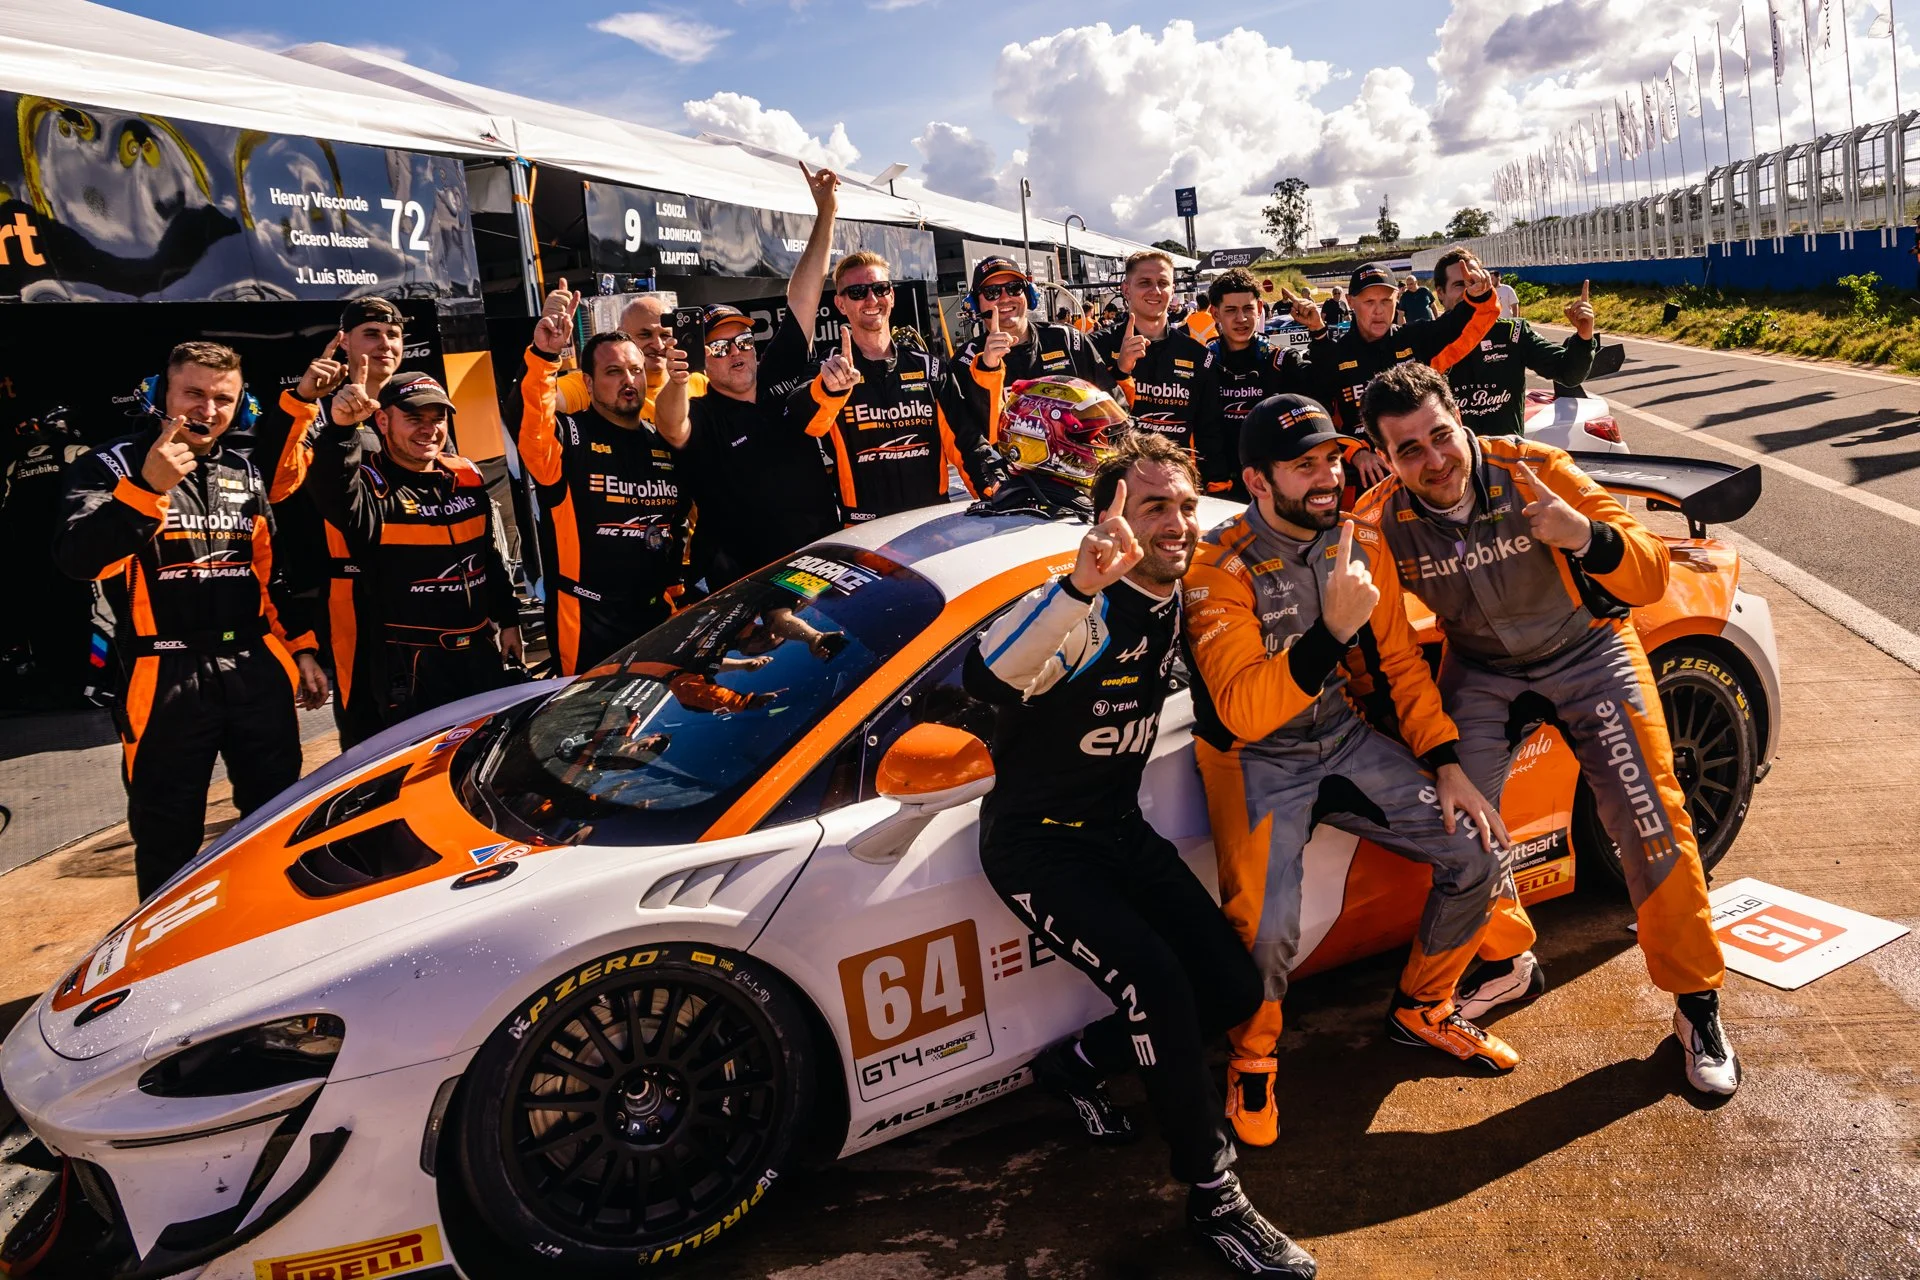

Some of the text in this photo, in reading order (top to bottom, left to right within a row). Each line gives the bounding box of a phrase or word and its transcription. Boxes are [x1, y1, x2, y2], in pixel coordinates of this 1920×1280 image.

[269, 187, 369, 212] Henry Visconde
[656, 202, 687, 218] L.SOUZA
[381, 198, 430, 250] 72
[625, 208, 641, 252] 9
[330, 232, 370, 249] Nasser
[658, 227, 702, 243] B.BONIFACIO
[660, 251, 700, 265] V.BAPTISTA
[296, 267, 308, 284] J.
[336, 268, 379, 285] Ribeiro
[1136, 380, 1190, 399] urobike
[1454, 384, 1497, 392] BOTECO
[1455, 389, 1511, 408] ão Bento
[855, 400, 933, 421] Eurobike
[858, 452, 876, 463] MC
[606, 475, 678, 498] Eurobike
[164, 509, 253, 531] Eurobike
[596, 527, 620, 536] MC
[1047, 560, 1076, 575] Enzo
[1420, 535, 1532, 579] Eurobike
[158, 569, 187, 580] MC
[786, 555, 873, 591] ENDURANCE
[573, 585, 601, 601] sparco
[1102, 675, 1138, 688] GOODYEAR
[1662, 657, 1733, 686] P ZERO
[1112, 700, 1138, 713] YEMA
[1516, 733, 1553, 762] ento
[1595, 698, 1665, 840] Eurobike
[1518, 872, 1561, 893] ELLI
[135, 880, 221, 951] 64
[1723, 899, 1762, 916] GT4
[1730, 914, 1823, 955] 15
[530, 950, 659, 1024] P ZERO
[862, 935, 966, 1041] 64
[1011, 893, 1157, 1067] ALPINE
[925, 1032, 976, 1057] ENDURANCE
[862, 1047, 924, 1086] GT4
[981, 1081, 1019, 1101] PAULO
[858, 1071, 1022, 1139] McLaren
[651, 1184, 765, 1264] PIRELLI
